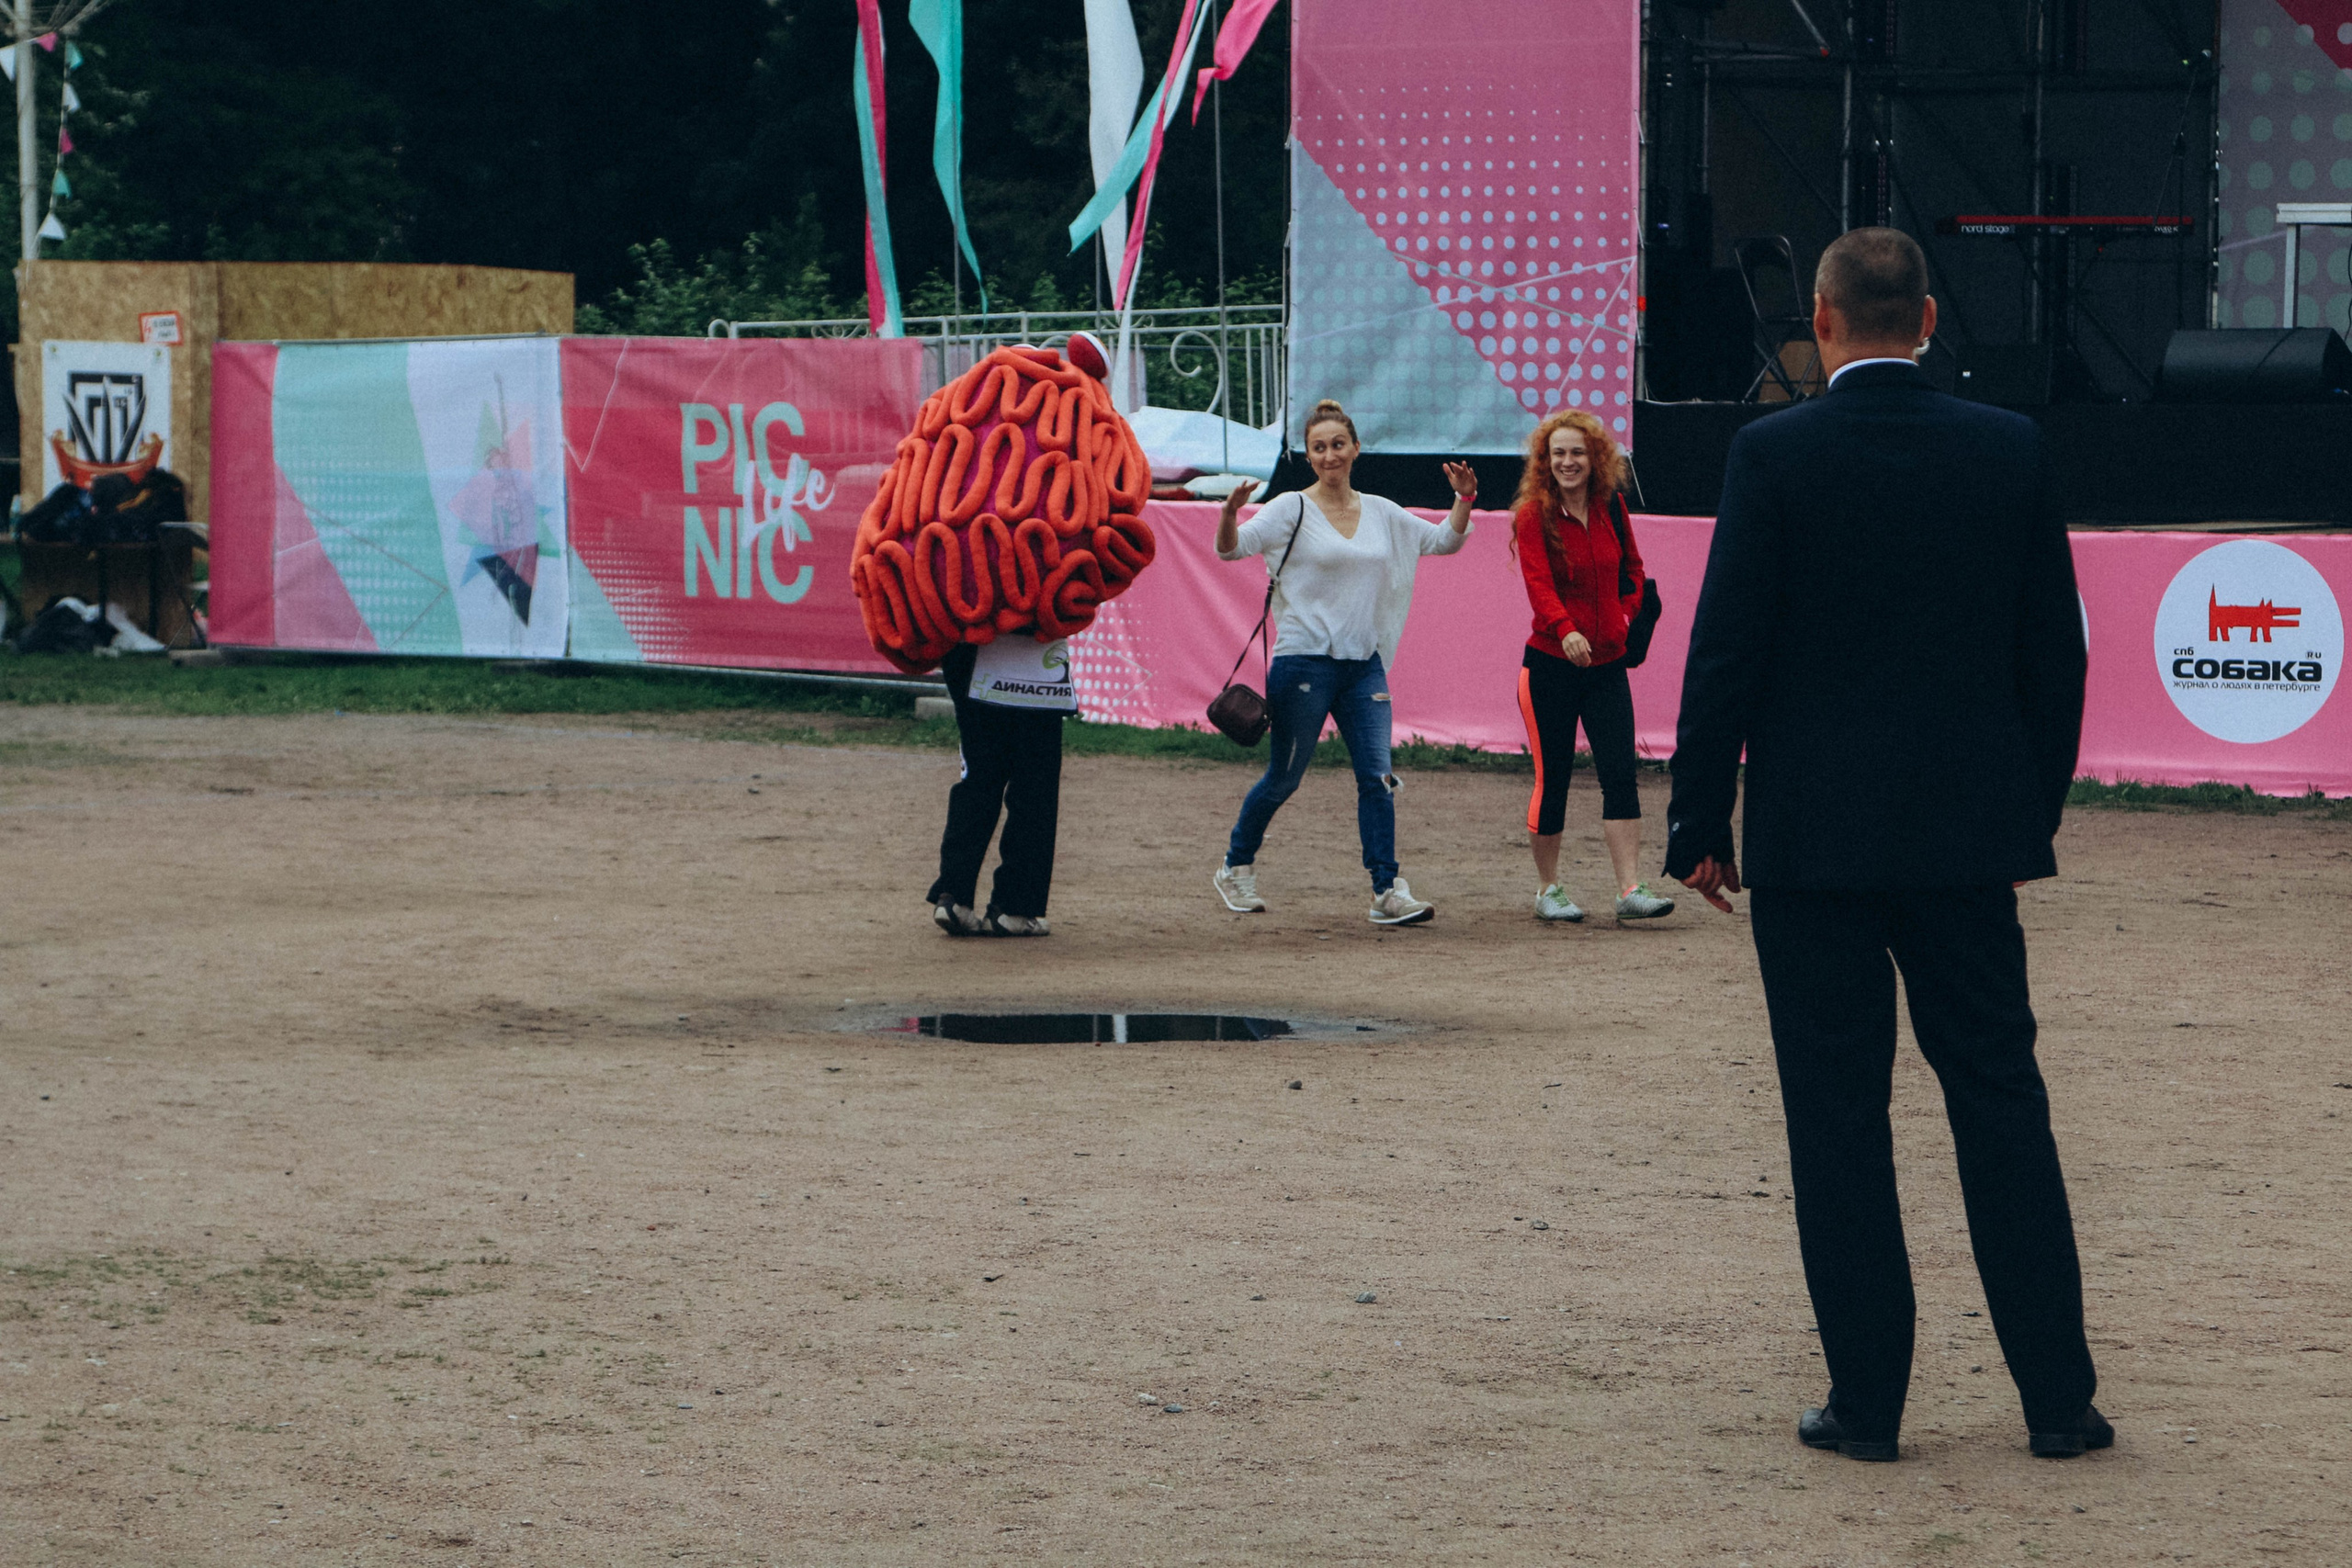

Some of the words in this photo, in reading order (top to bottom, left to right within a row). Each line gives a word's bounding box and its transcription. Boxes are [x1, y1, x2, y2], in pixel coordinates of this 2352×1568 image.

[1961, 224, 1984, 233] nord
[1984, 224, 2010, 234] stage
[680, 401, 810, 497] PIC
[684, 506, 814, 604] NIC
[991, 680, 1071, 697] ДИНАСТИЯ
[2173, 681, 2210, 689] журнал
[2262, 682, 2321, 693] петербурге
